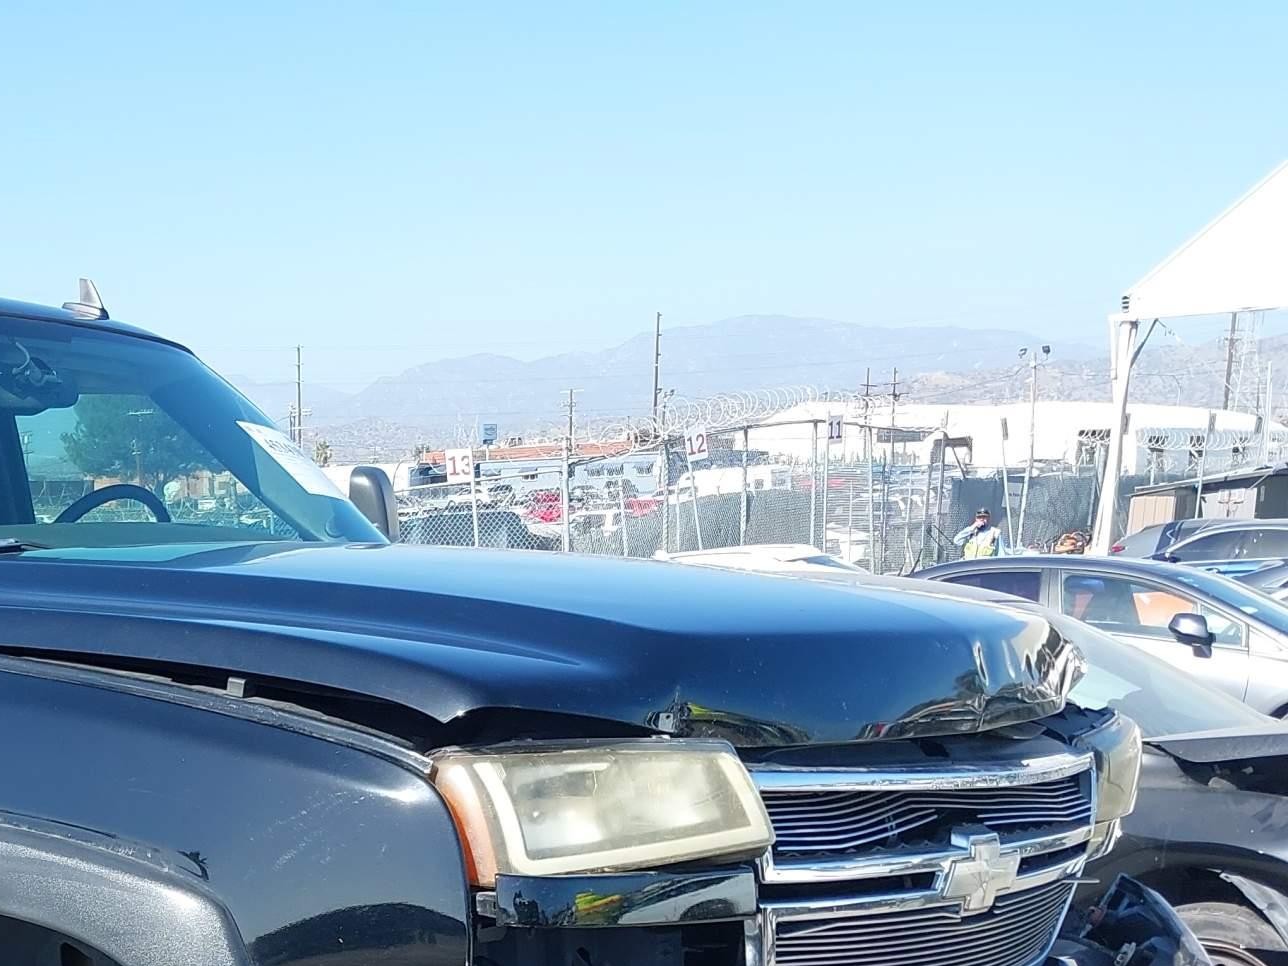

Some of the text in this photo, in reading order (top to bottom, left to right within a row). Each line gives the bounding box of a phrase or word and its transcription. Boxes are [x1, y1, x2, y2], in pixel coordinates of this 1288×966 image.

[828, 420, 842, 439] 11
[686, 433, 706, 456] 12
[447, 455, 471, 476] 13
